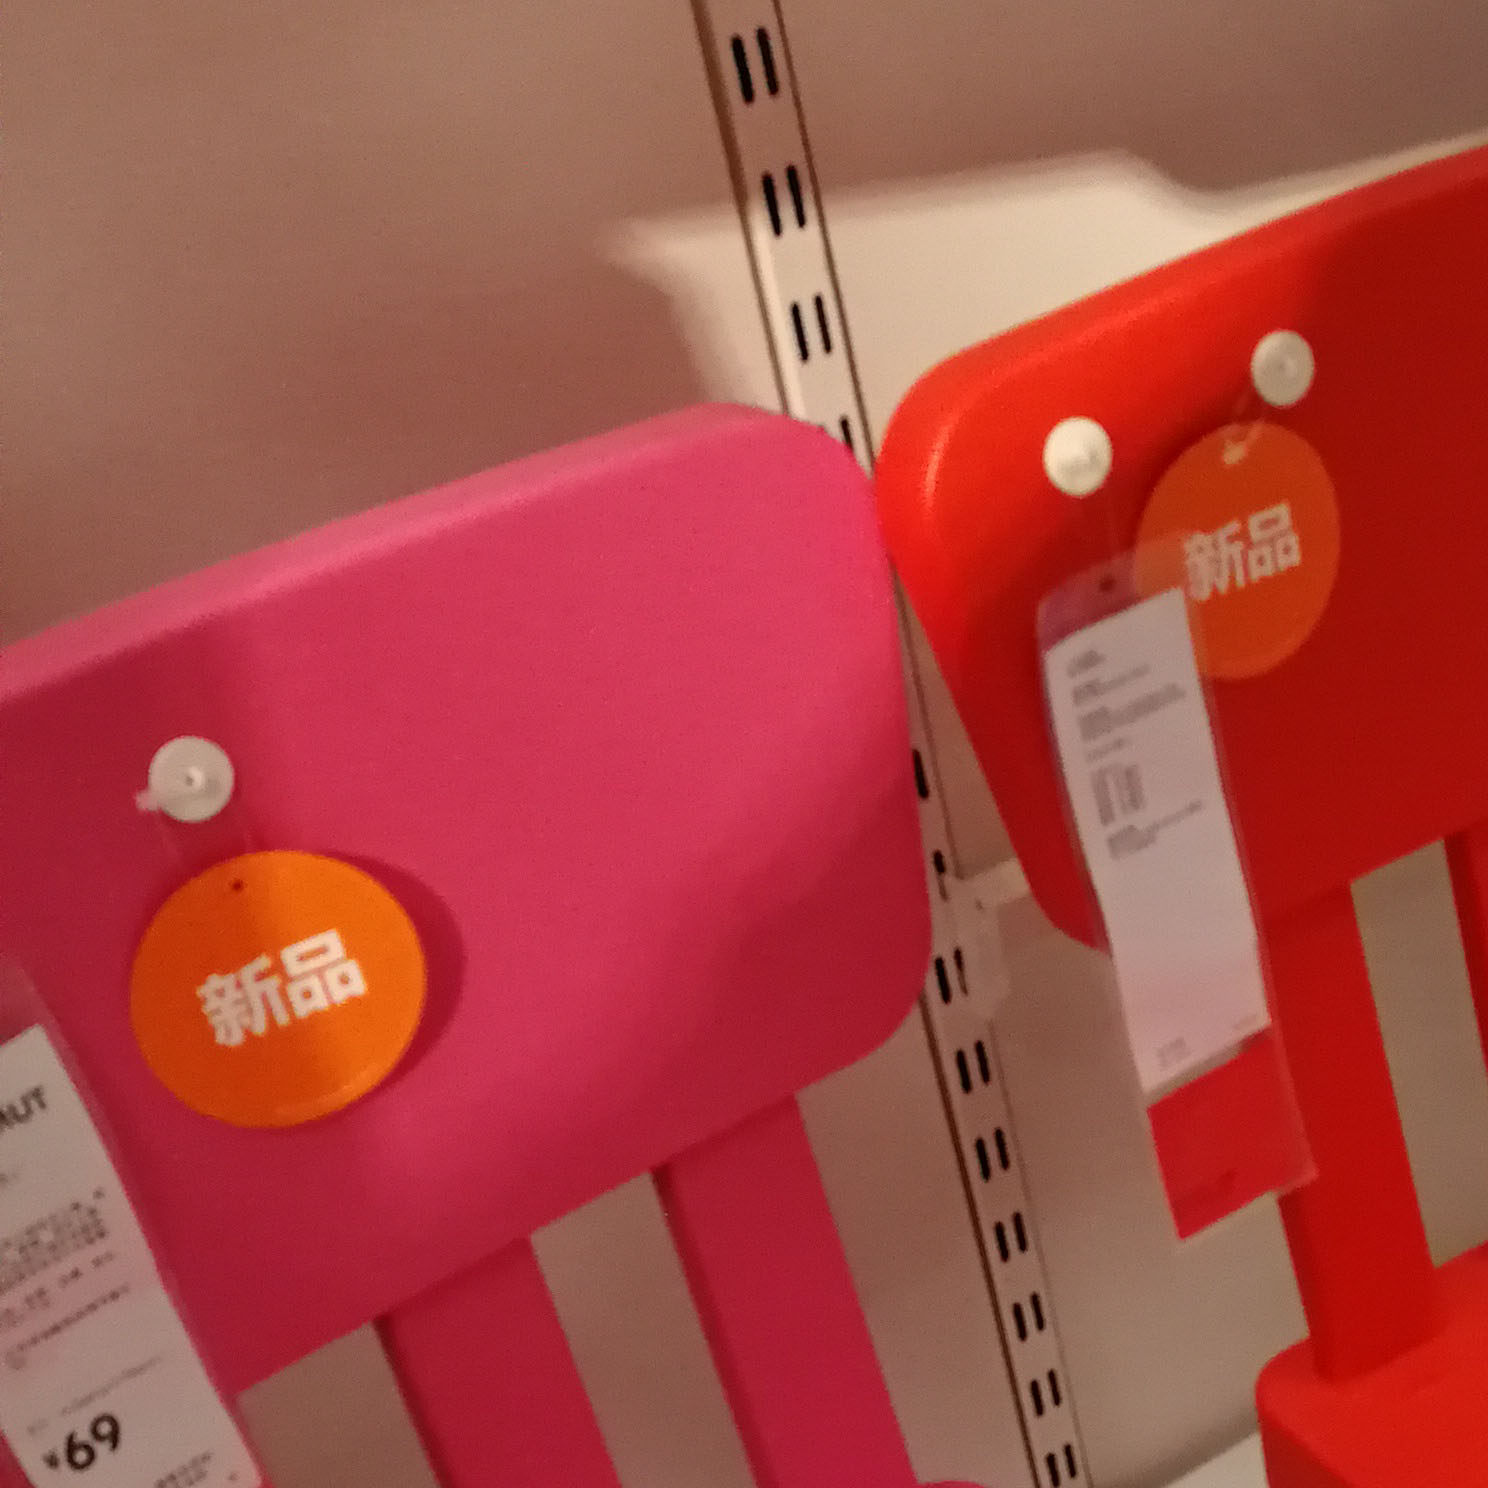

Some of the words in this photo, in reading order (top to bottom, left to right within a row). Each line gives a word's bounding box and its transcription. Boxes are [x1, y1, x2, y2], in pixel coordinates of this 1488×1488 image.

[1183, 502, 1301, 602] 新品
[196, 928, 368, 1047] 新品
[42, 1413, 121, 1471] ¥69
